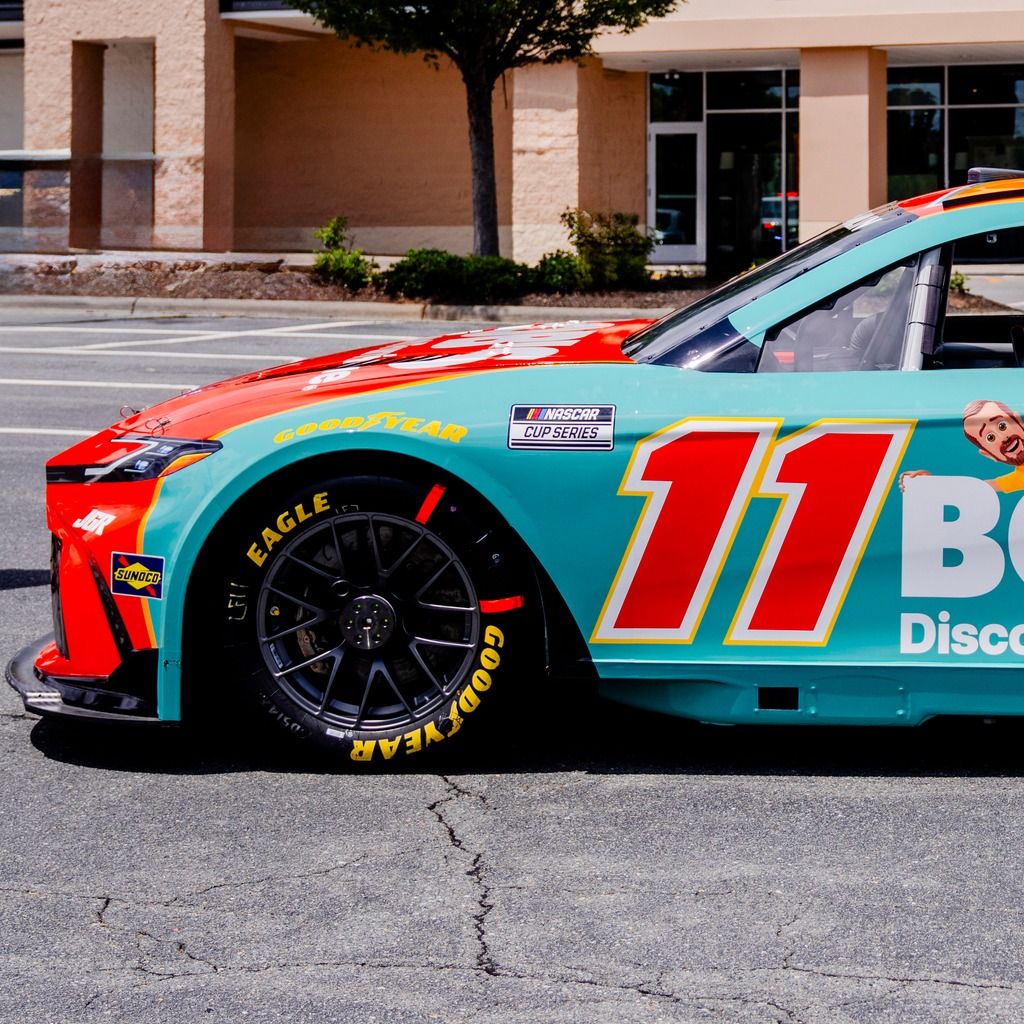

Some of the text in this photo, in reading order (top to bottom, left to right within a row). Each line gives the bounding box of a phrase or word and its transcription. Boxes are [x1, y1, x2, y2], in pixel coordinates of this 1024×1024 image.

[273, 411, 468, 444] GOODYEAR
[544, 408, 600, 420] NASCAR
[524, 426, 599, 439] CUP SERIES
[72, 509, 117, 536] JGR
[246, 491, 330, 567] EAGLE
[590, 416, 918, 647] 11
[116, 569, 159, 583] SUNOCO
[350, 625, 504, 761] GOODYEAR
